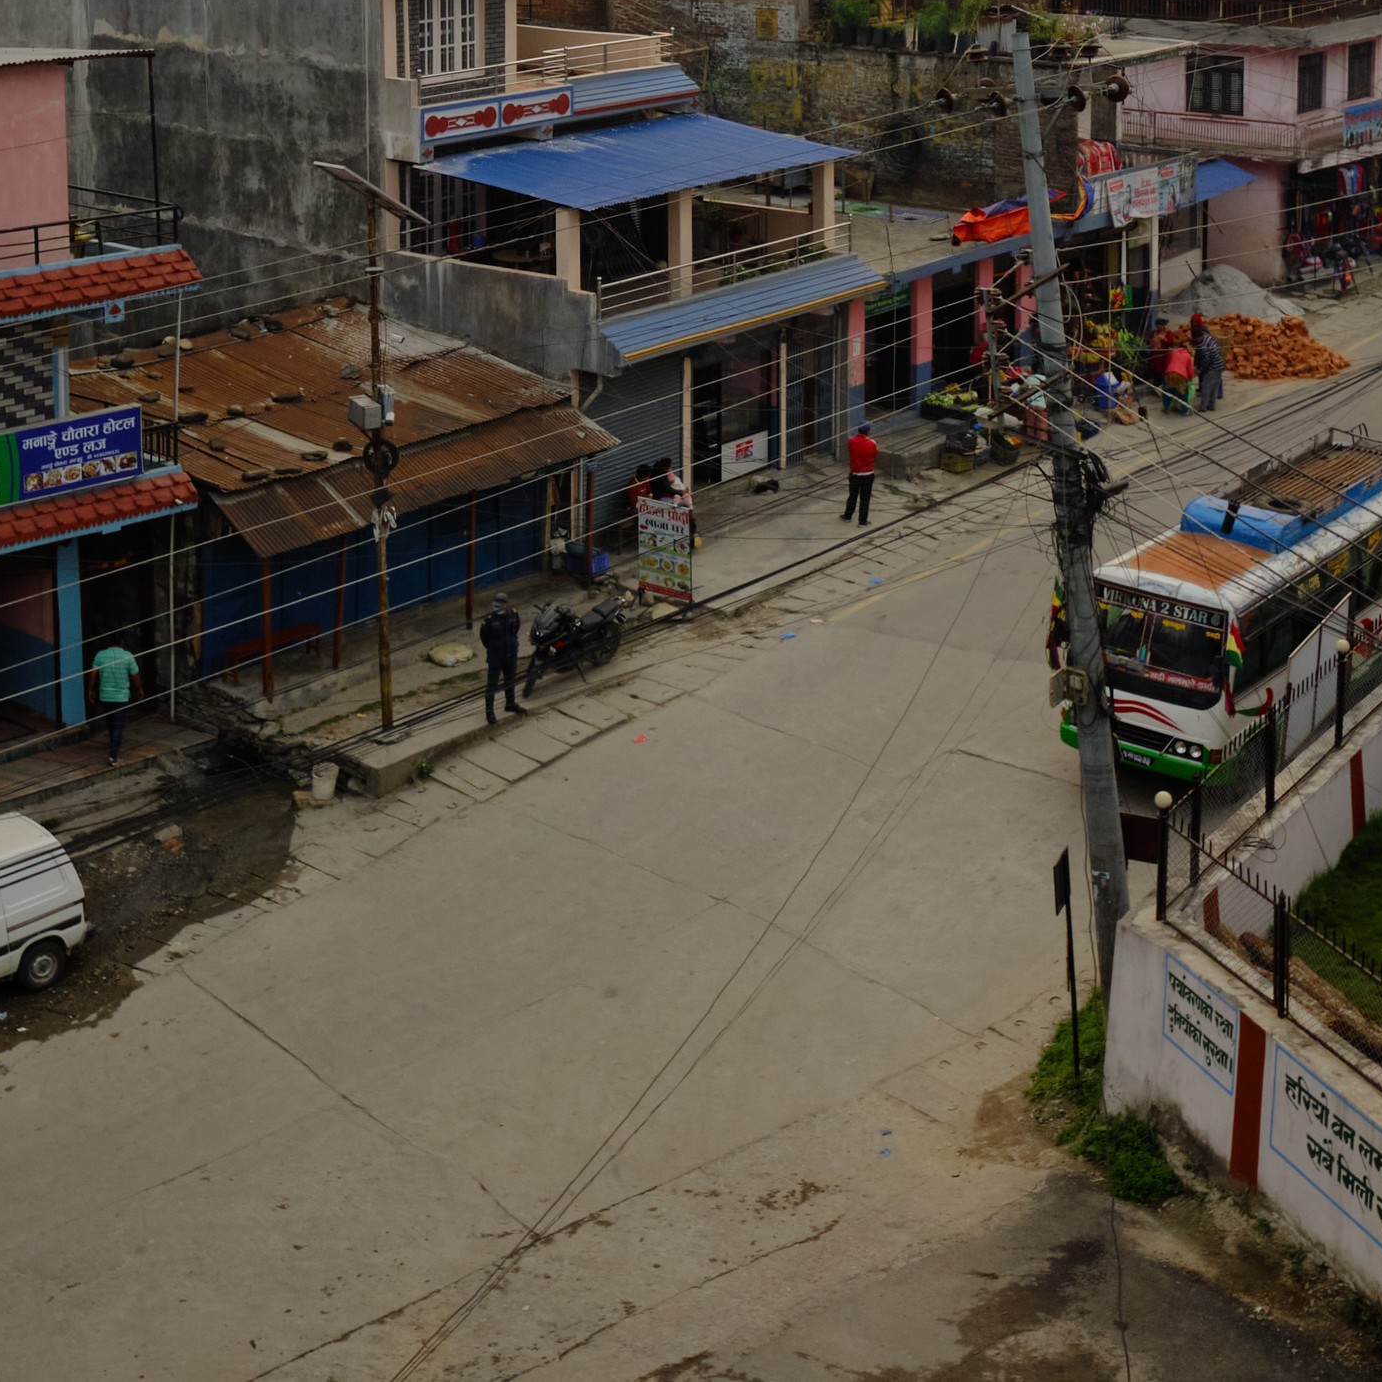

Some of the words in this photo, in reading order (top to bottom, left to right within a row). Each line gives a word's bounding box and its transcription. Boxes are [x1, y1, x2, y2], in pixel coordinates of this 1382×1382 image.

[103, 417, 136, 434] होटल
[54, 444, 79, 459] एण्ड
[83, 438, 107, 453] लज
[1160, 602, 1170, 614] 2
[1173, 605, 1208, 624] STAR
[1285, 1074, 1330, 1129] हरियो
[1331, 1113, 1356, 1151] वन
[1336, 1153, 1375, 1212] मिली
